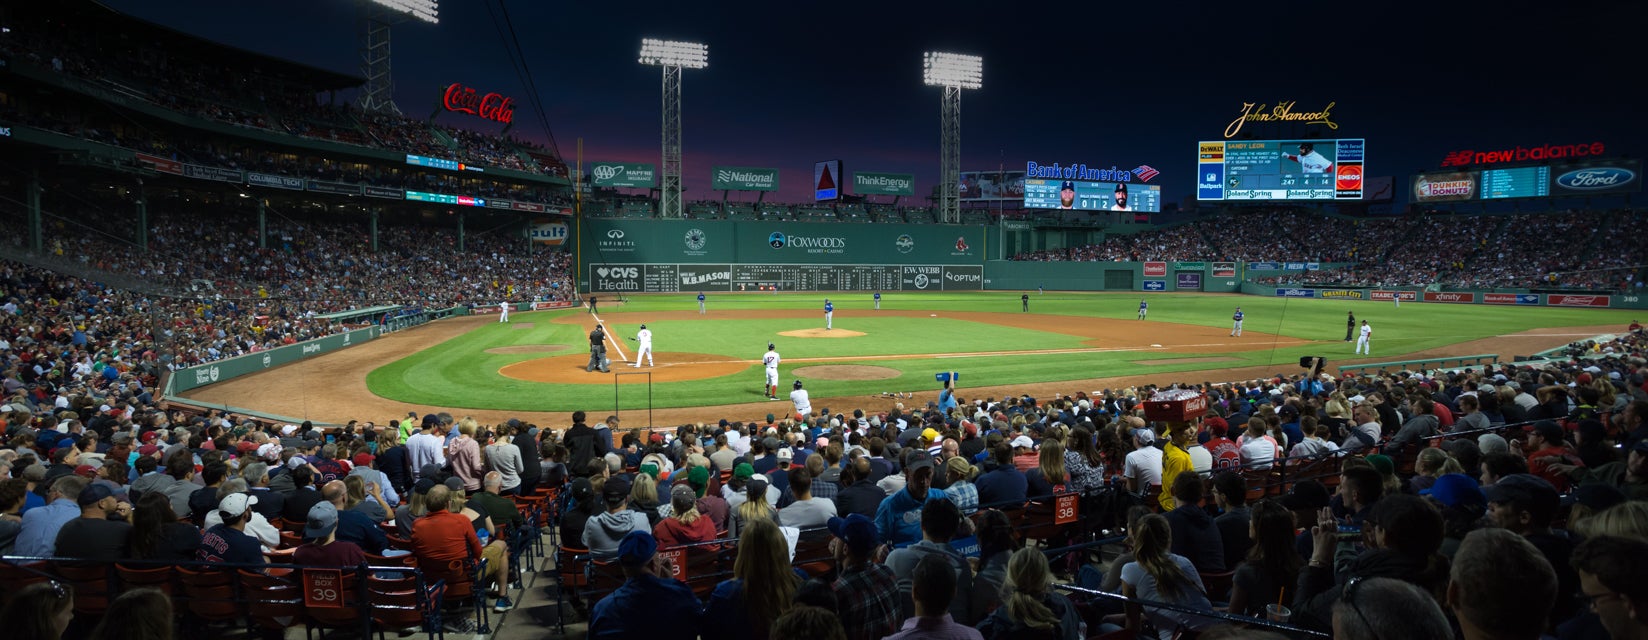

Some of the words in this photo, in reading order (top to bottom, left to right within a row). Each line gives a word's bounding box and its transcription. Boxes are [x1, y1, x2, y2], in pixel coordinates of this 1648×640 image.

[1224, 102, 1269, 138] John
[1271, 100, 1338, 129] Hancock
[1476, 150, 1514, 164] new
[1515, 142, 1605, 161] balance
[730, 172, 773, 182] National
[1027, 161, 1062, 178] Bank
[1064, 164, 1078, 180] of
[1078, 164, 1131, 182] America
[249, 174, 282, 184] COLUMBIA
[283, 179, 300, 187] TECH
[857, 176, 908, 188] ThinkEnergy
[1433, 181, 1472, 189] DUNKIN'
[1571, 170, 1618, 188] Ford
[787, 236, 845, 248] FOXWOODS
[611, 268, 638, 278] CVS
[599, 279, 639, 290] Health
[1058, 508, 1074, 519] 38
[312, 589, 337, 601] 39
